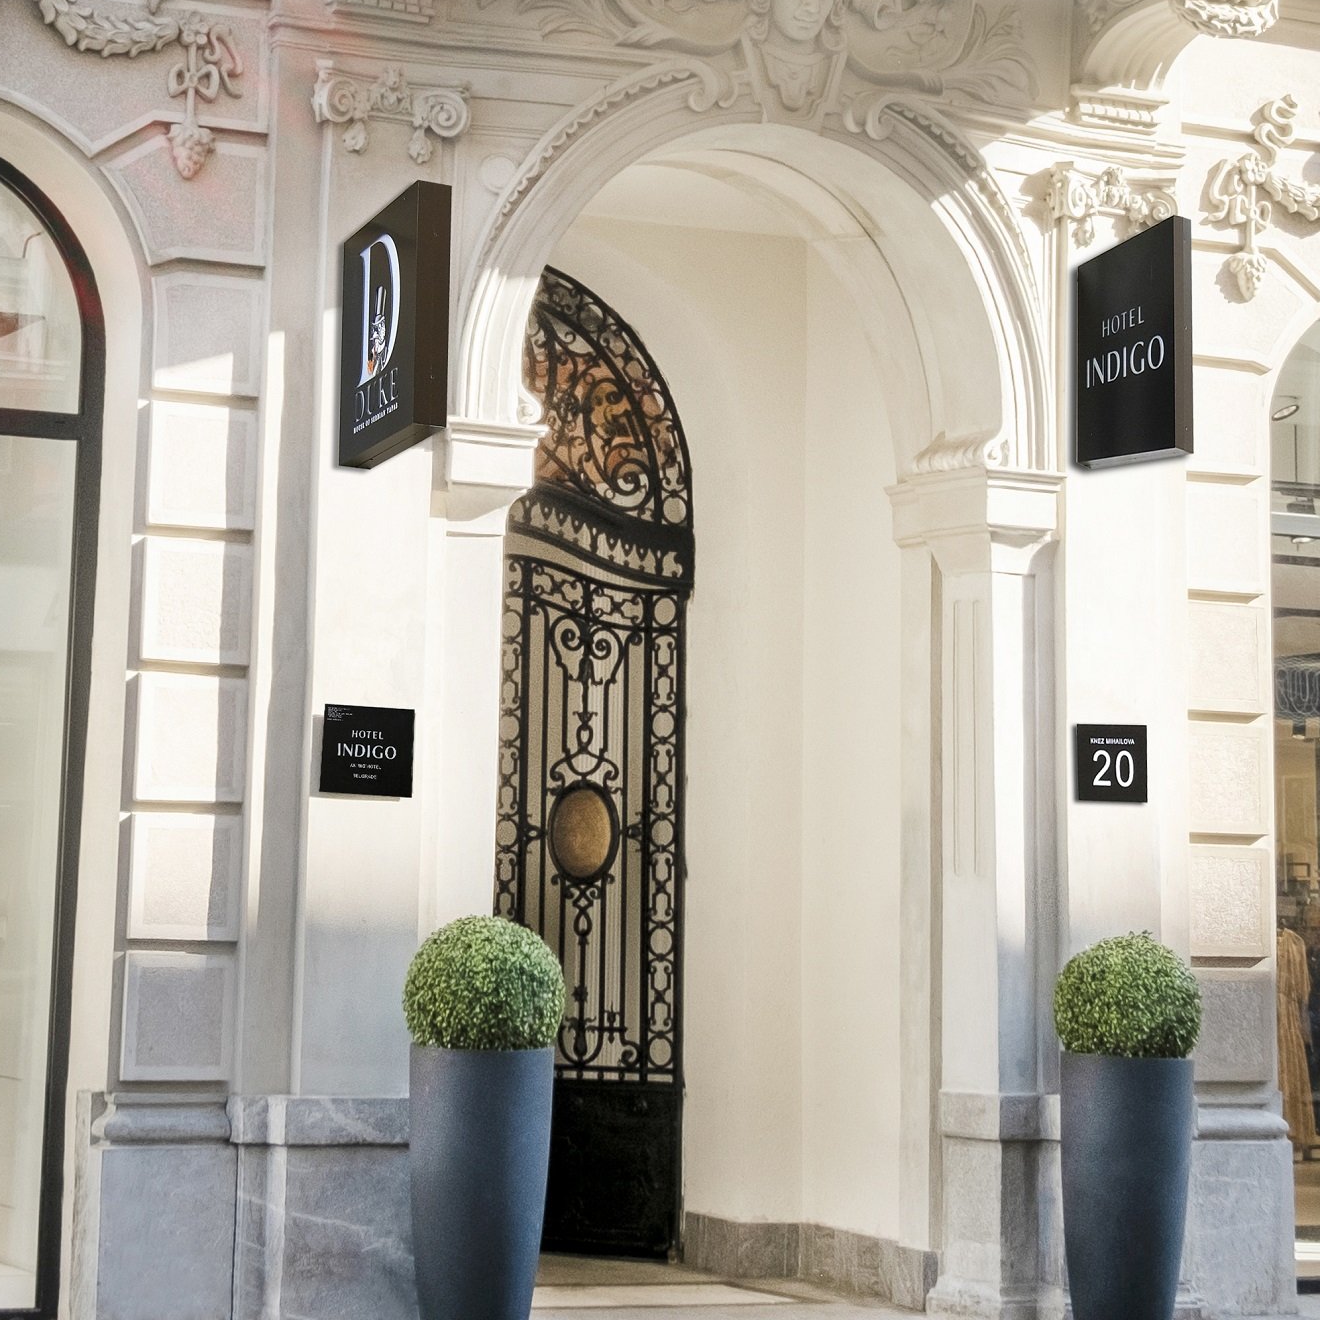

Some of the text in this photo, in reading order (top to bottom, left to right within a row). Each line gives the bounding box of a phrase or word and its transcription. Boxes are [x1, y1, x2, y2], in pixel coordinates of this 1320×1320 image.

[1102, 305, 1145, 338] HOTEL
[1086, 334, 1165, 389] INDIGO
[354, 367, 399, 422] DUKE
[337, 742, 397, 760] INDIGO
[351, 729, 384, 740] HOTEL
[1090, 737, 1135, 745] KNEZ MIHAILOVA
[1092, 749, 1134, 788] 20
